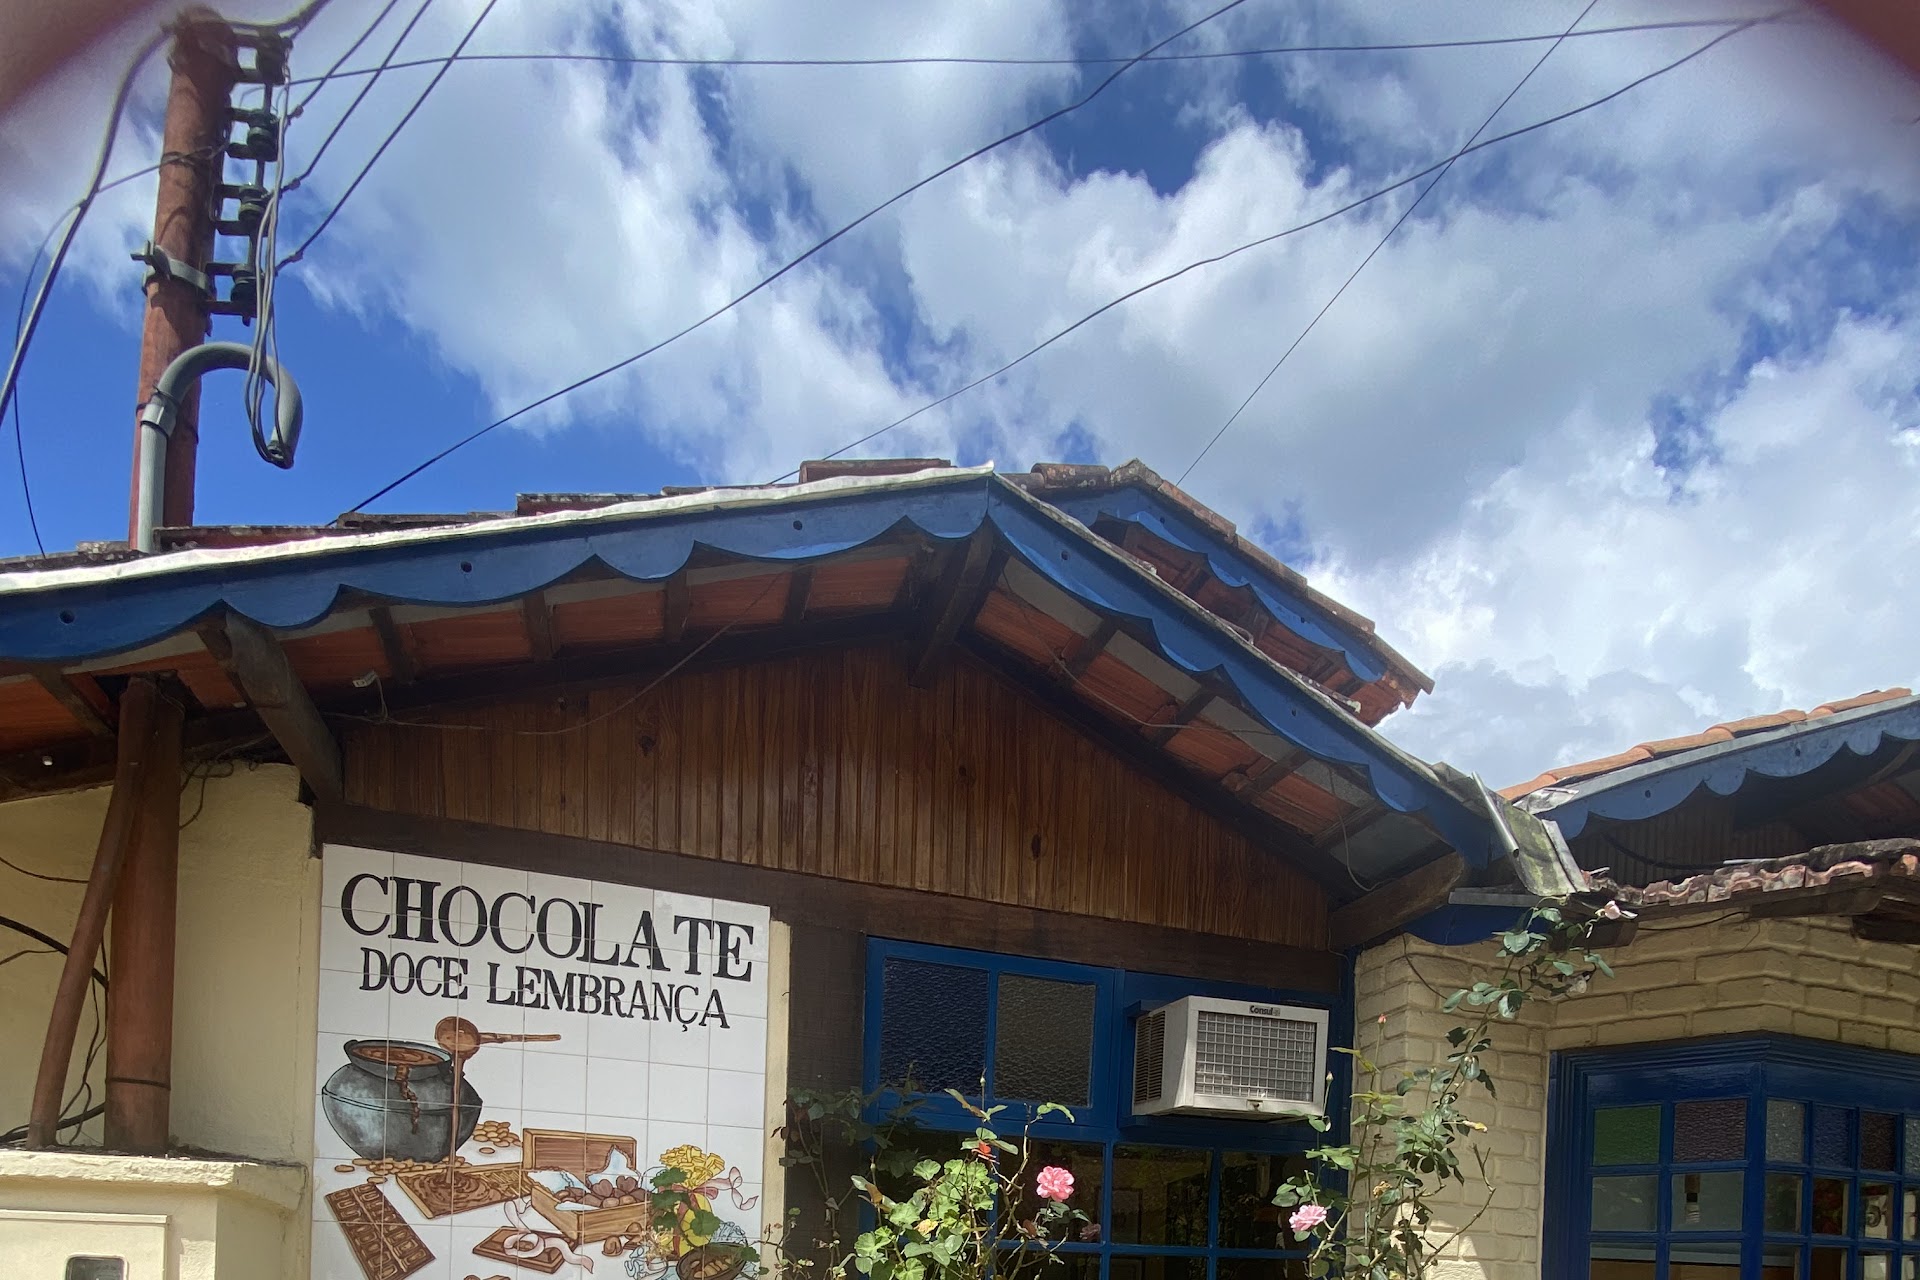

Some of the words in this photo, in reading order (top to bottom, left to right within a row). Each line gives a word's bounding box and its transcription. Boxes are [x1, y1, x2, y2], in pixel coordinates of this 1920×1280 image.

[341, 873, 754, 982] CHOCOLATE
[359, 947, 469, 999] DOCE
[486, 962, 730, 1032] LEMBRANÇA
[1250, 1005, 1273, 1016] Consul
